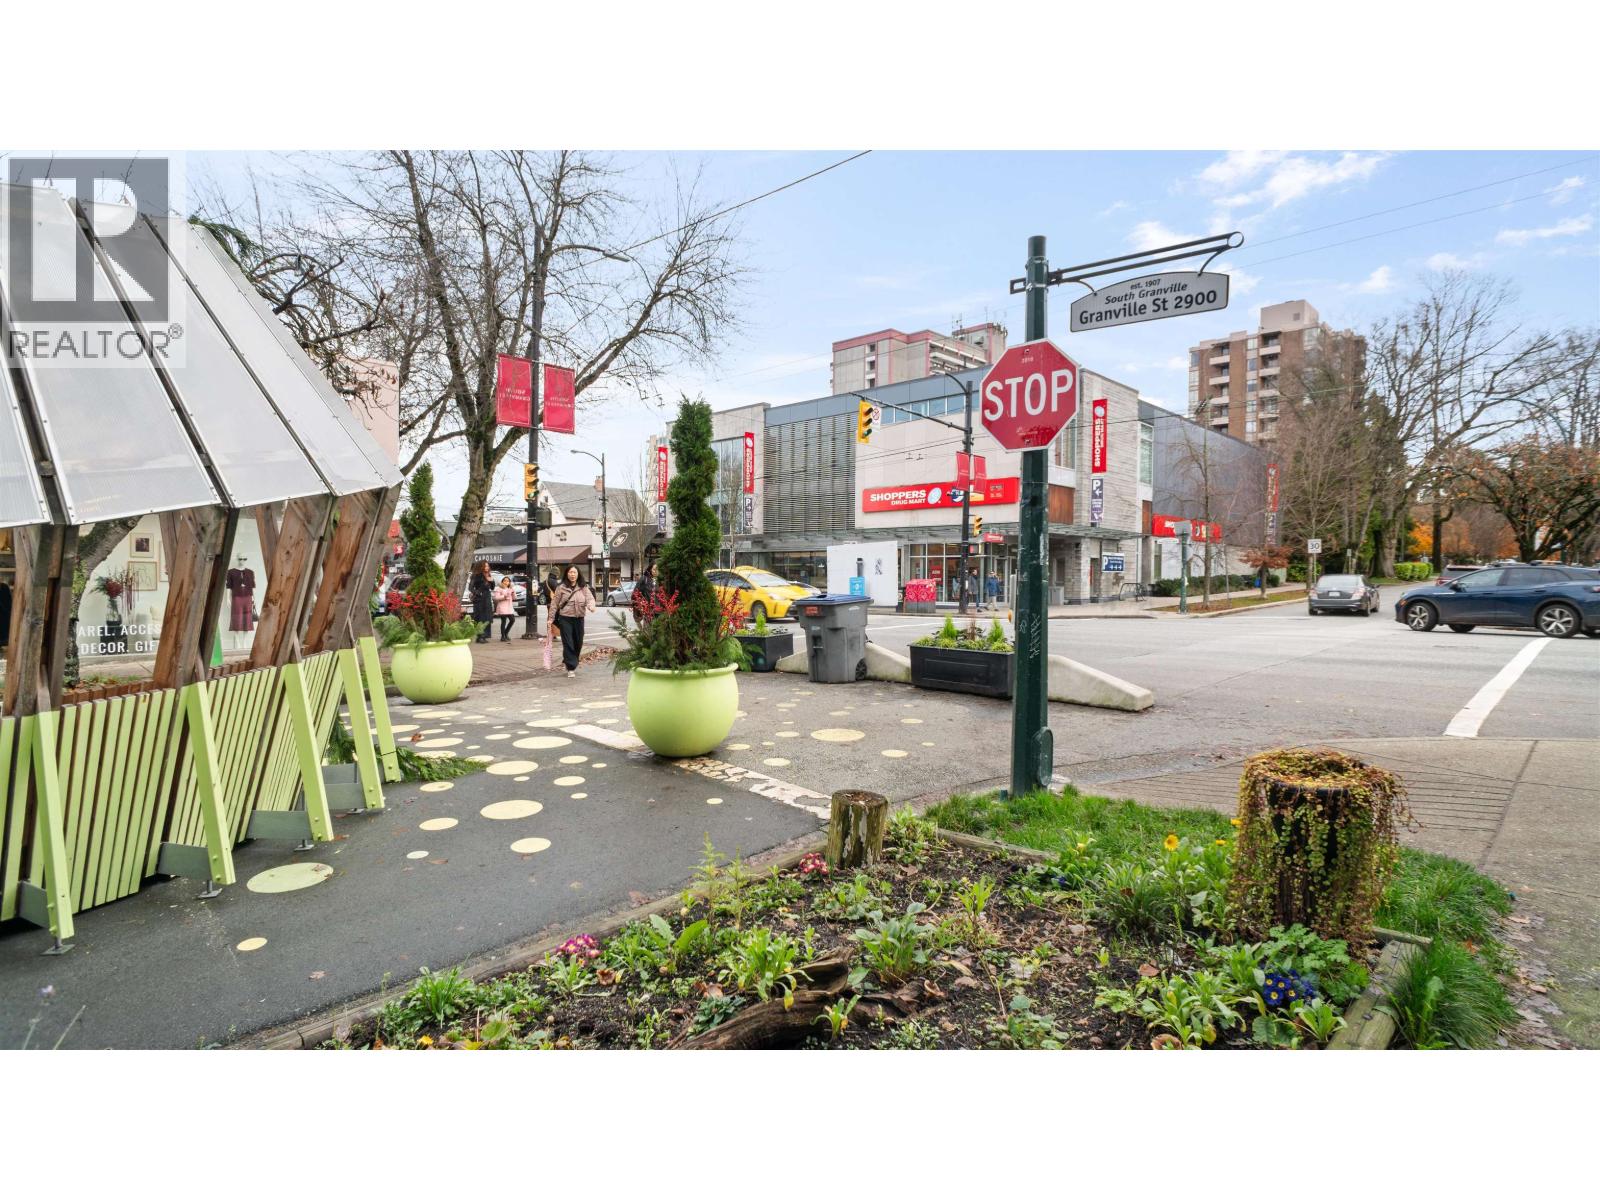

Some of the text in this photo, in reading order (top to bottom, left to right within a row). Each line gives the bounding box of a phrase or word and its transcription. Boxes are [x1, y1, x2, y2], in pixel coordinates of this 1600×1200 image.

[1130, 278, 1161, 290] est. 1907
[1105, 282, 1188, 305] South Granville
[1079, 290, 1217, 325] Granville St 2900
[984, 368, 1074, 421] STOP
[1092, 479, 1101, 491] P
[870, 489, 927, 502] SHOPPERS
[78, 625, 115, 637] AREL.
[80, 641, 129, 654] DECOR.
